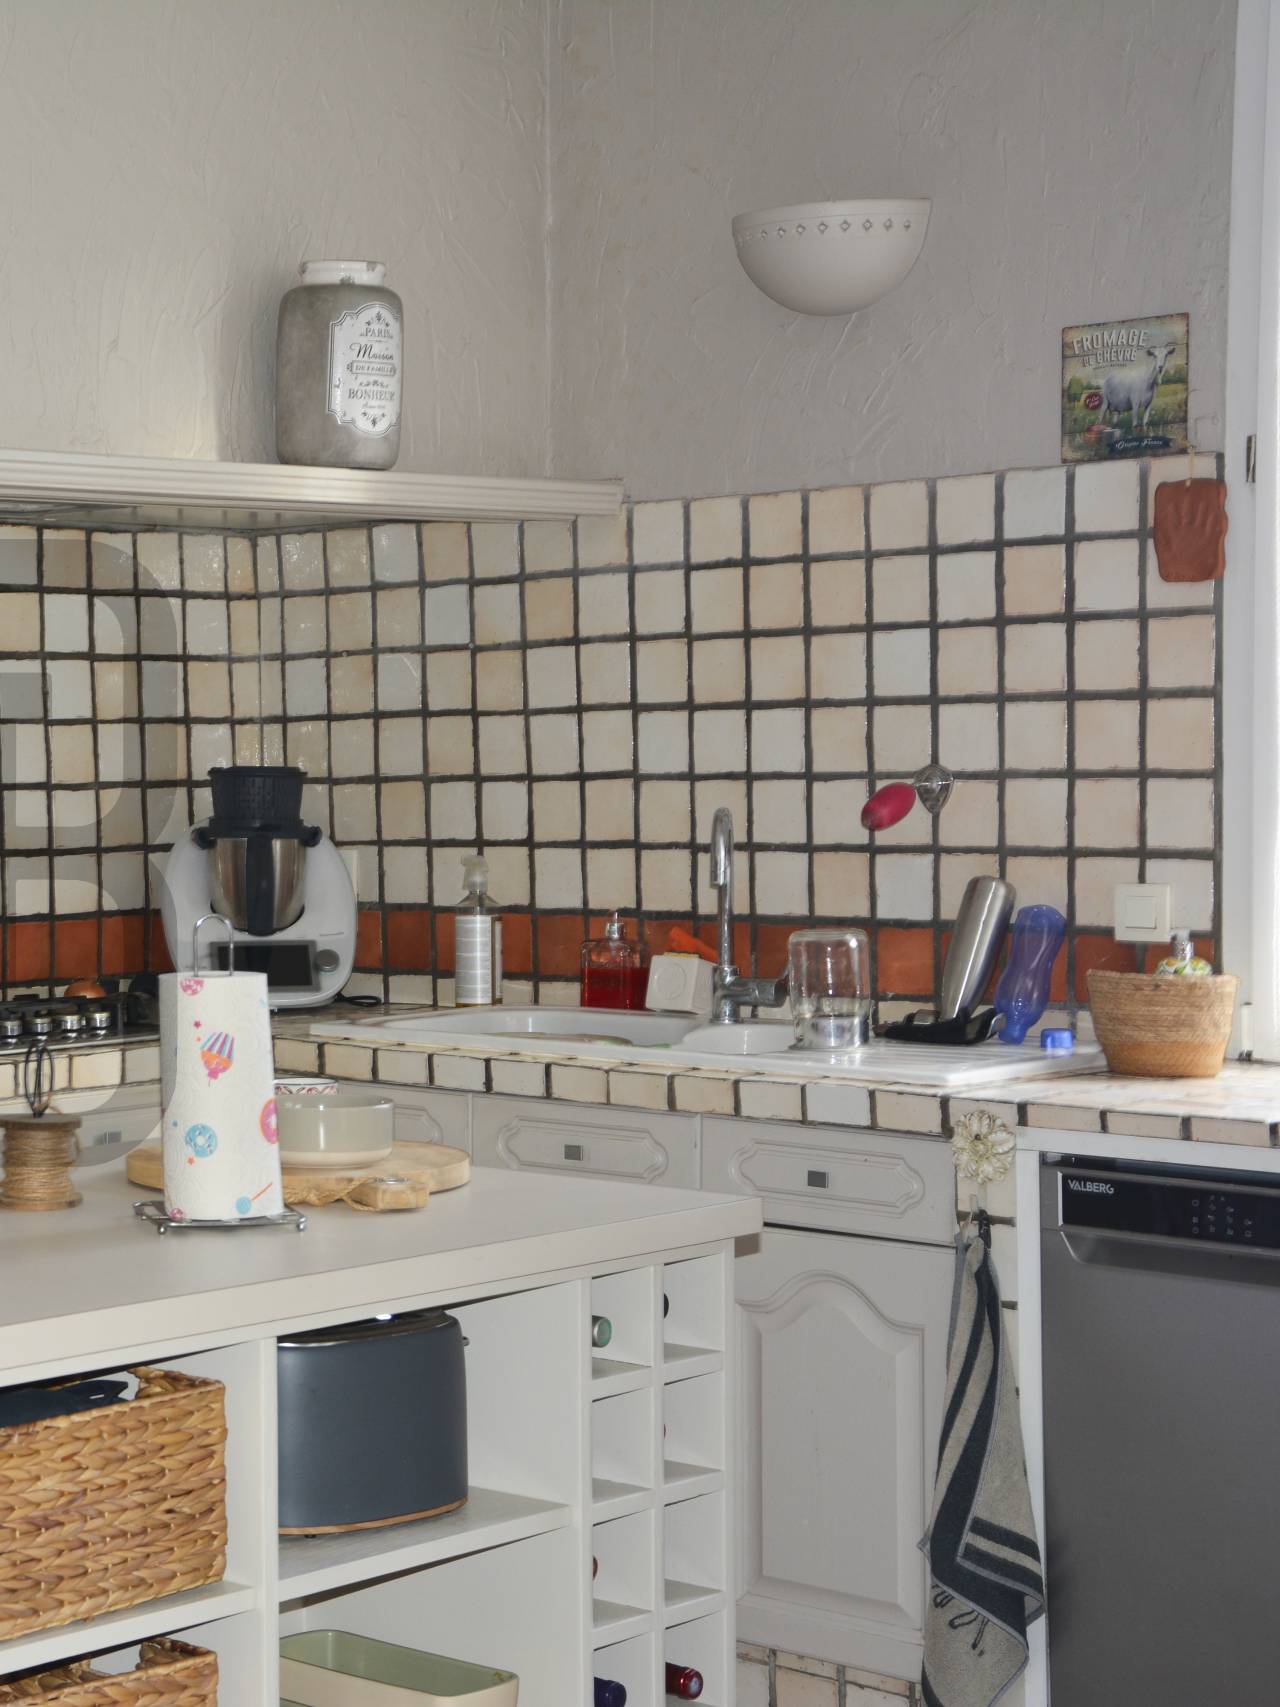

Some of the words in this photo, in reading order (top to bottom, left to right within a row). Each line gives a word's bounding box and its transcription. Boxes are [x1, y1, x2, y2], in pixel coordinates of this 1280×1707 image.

[365, 327, 392, 338] PARIS
[1072, 328, 1149, 354] FROMAGE
[349, 342, 394, 361] Maison
[348, 388, 395, 401] BONHEUR
[1068, 1179, 1114, 1195] VALBERG
